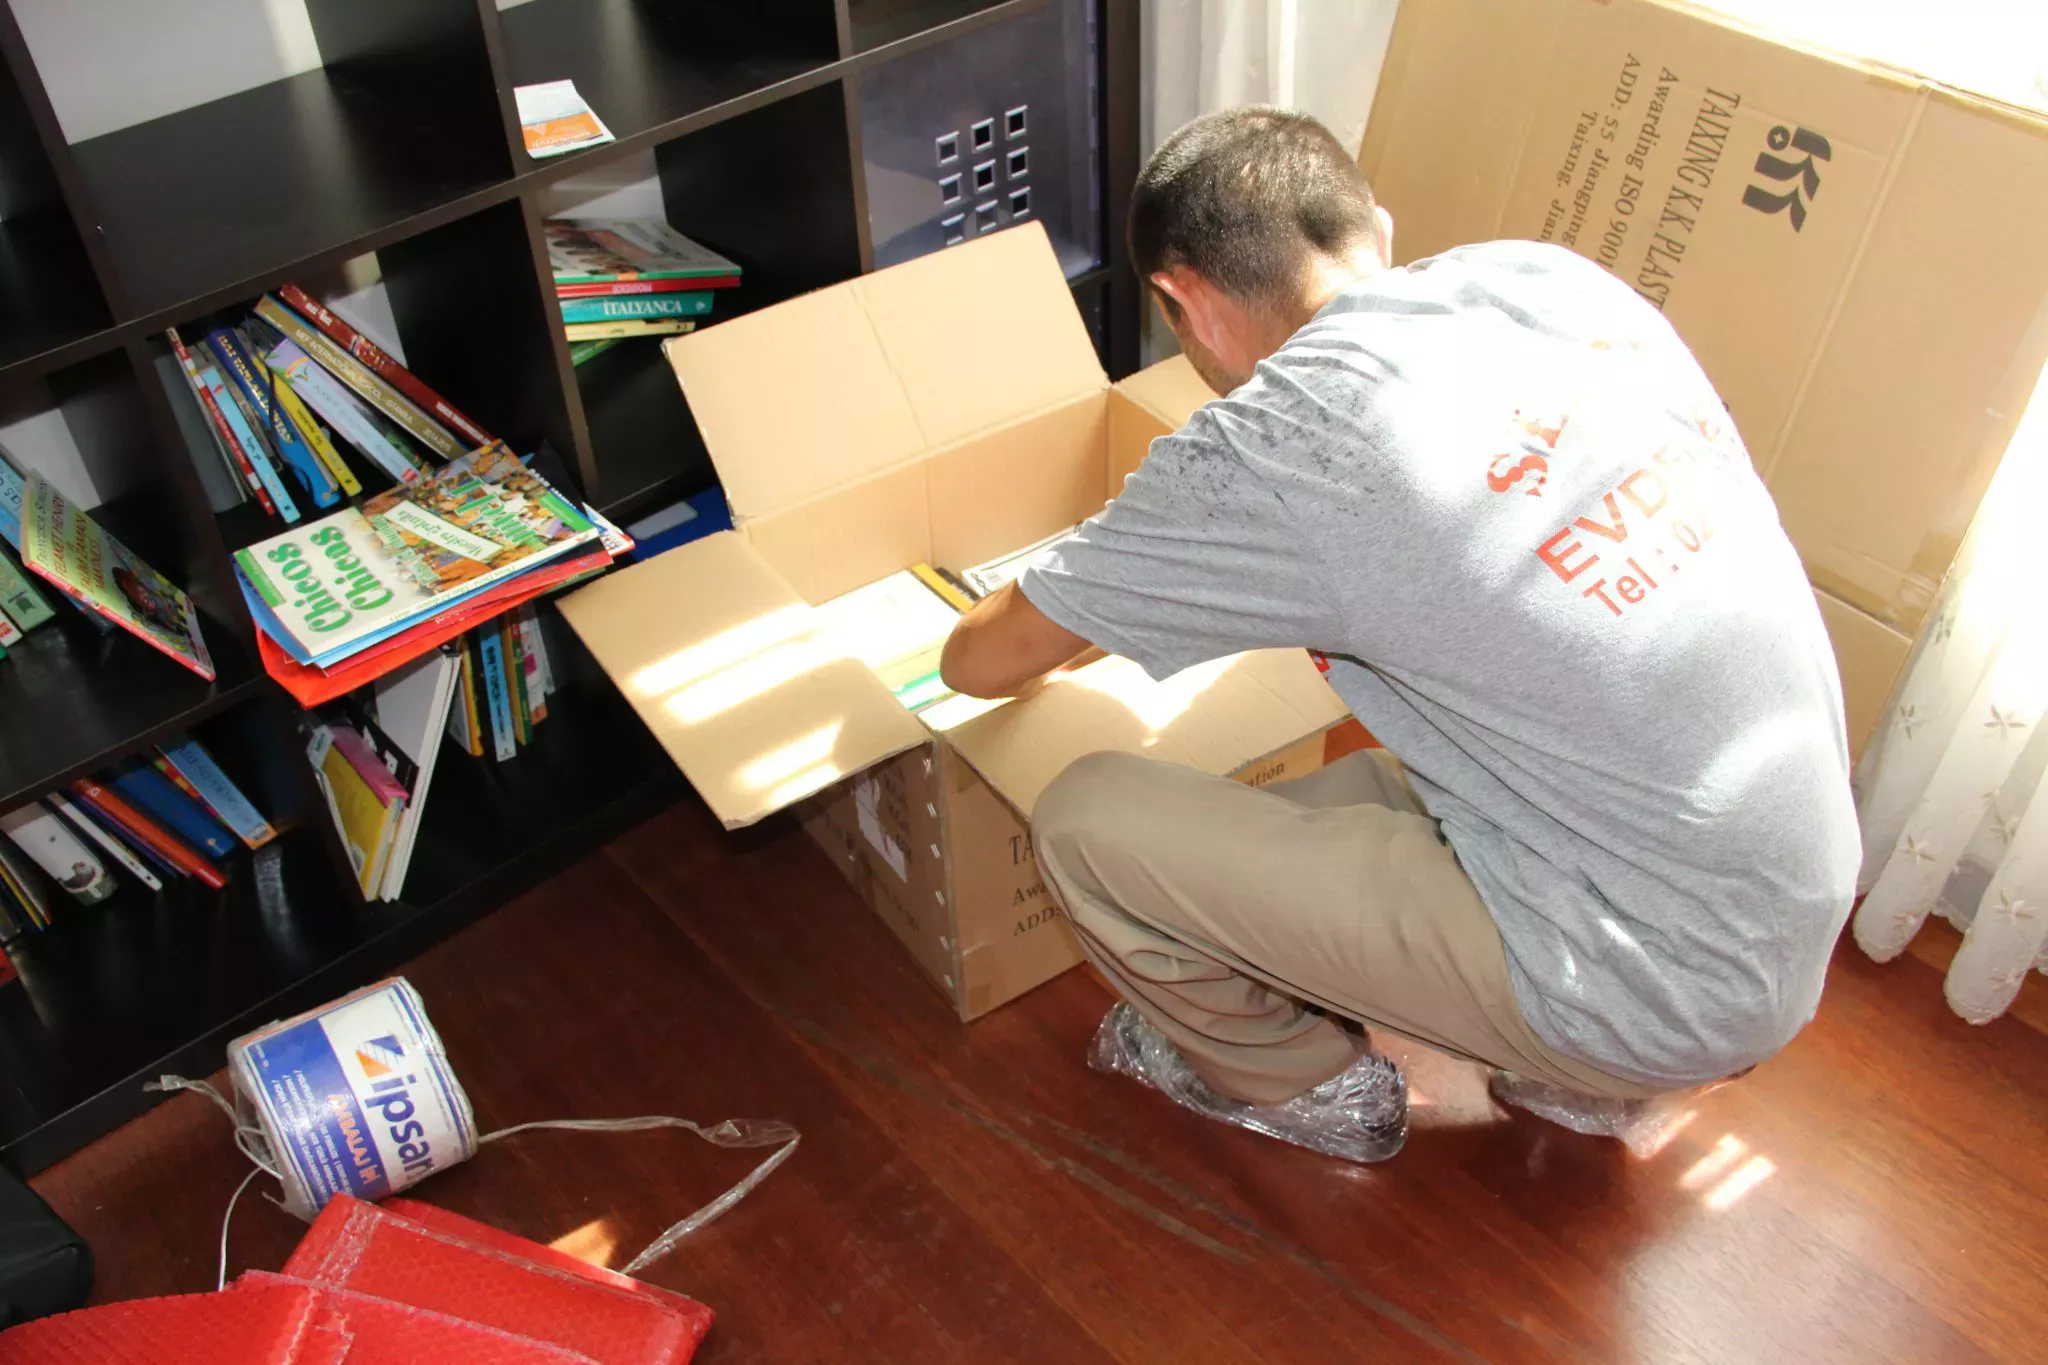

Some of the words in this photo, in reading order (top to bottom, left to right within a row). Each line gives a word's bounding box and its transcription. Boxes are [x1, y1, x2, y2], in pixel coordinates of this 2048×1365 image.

[1611, 53, 1640, 110] ADD:
[1625, 67, 1679, 171] Awarding
[1677, 88, 1740, 188] TAIXING
[1536, 200, 1565, 242] Jian
[1562, 148, 1609, 246] Jiangping
[1615, 174, 1643, 215] ISO
[306, 338, 360, 382] INTERNATIONAL
[454, 493, 539, 544] nivel
[267, 543, 353, 633] Chicos
[310, 526, 394, 611] Chicas
[1582, 555, 1658, 618] Tel
